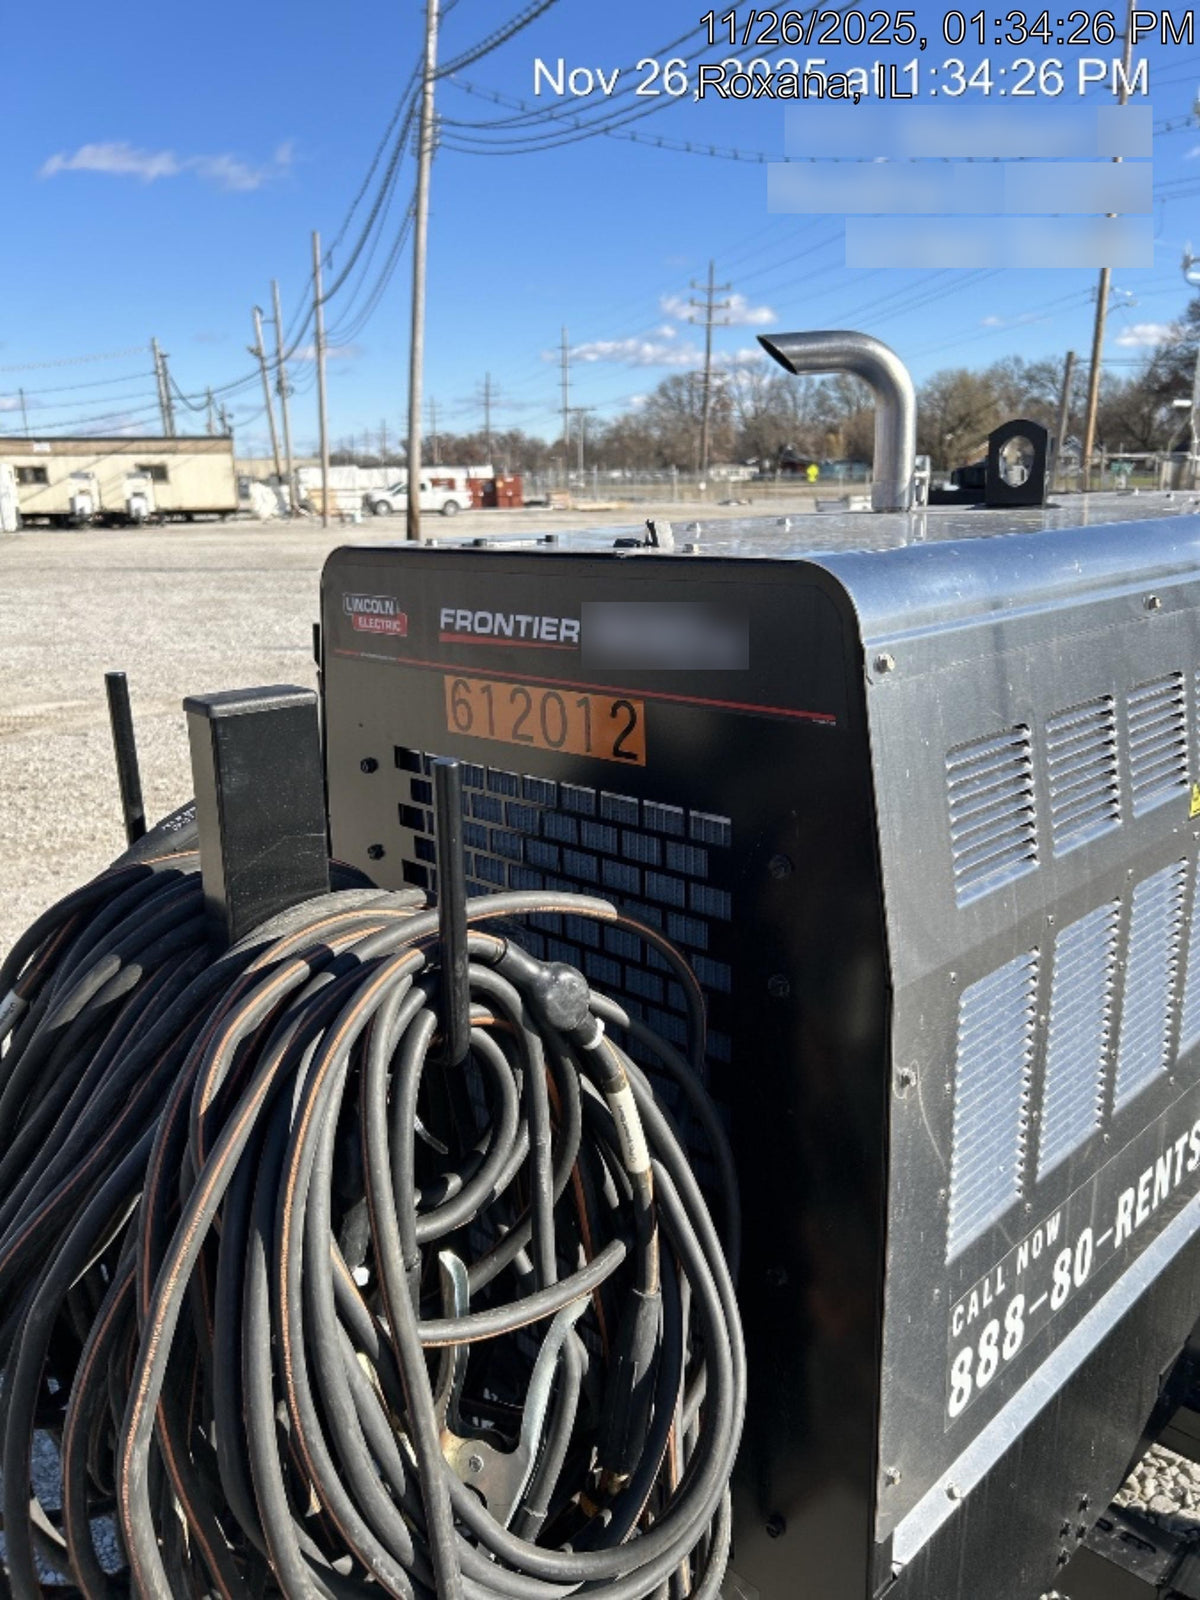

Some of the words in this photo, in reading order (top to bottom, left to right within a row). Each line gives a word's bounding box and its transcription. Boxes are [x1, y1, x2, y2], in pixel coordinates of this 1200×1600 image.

[345, 596, 395, 616] LINCOLN
[358, 615, 401, 633] ELECTRIC
[440, 607, 581, 643] FRONTIER
[451, 678, 639, 761] 612012
[952, 1266, 1007, 1338] CALL
[1016, 1211, 1061, 1275] NOW
